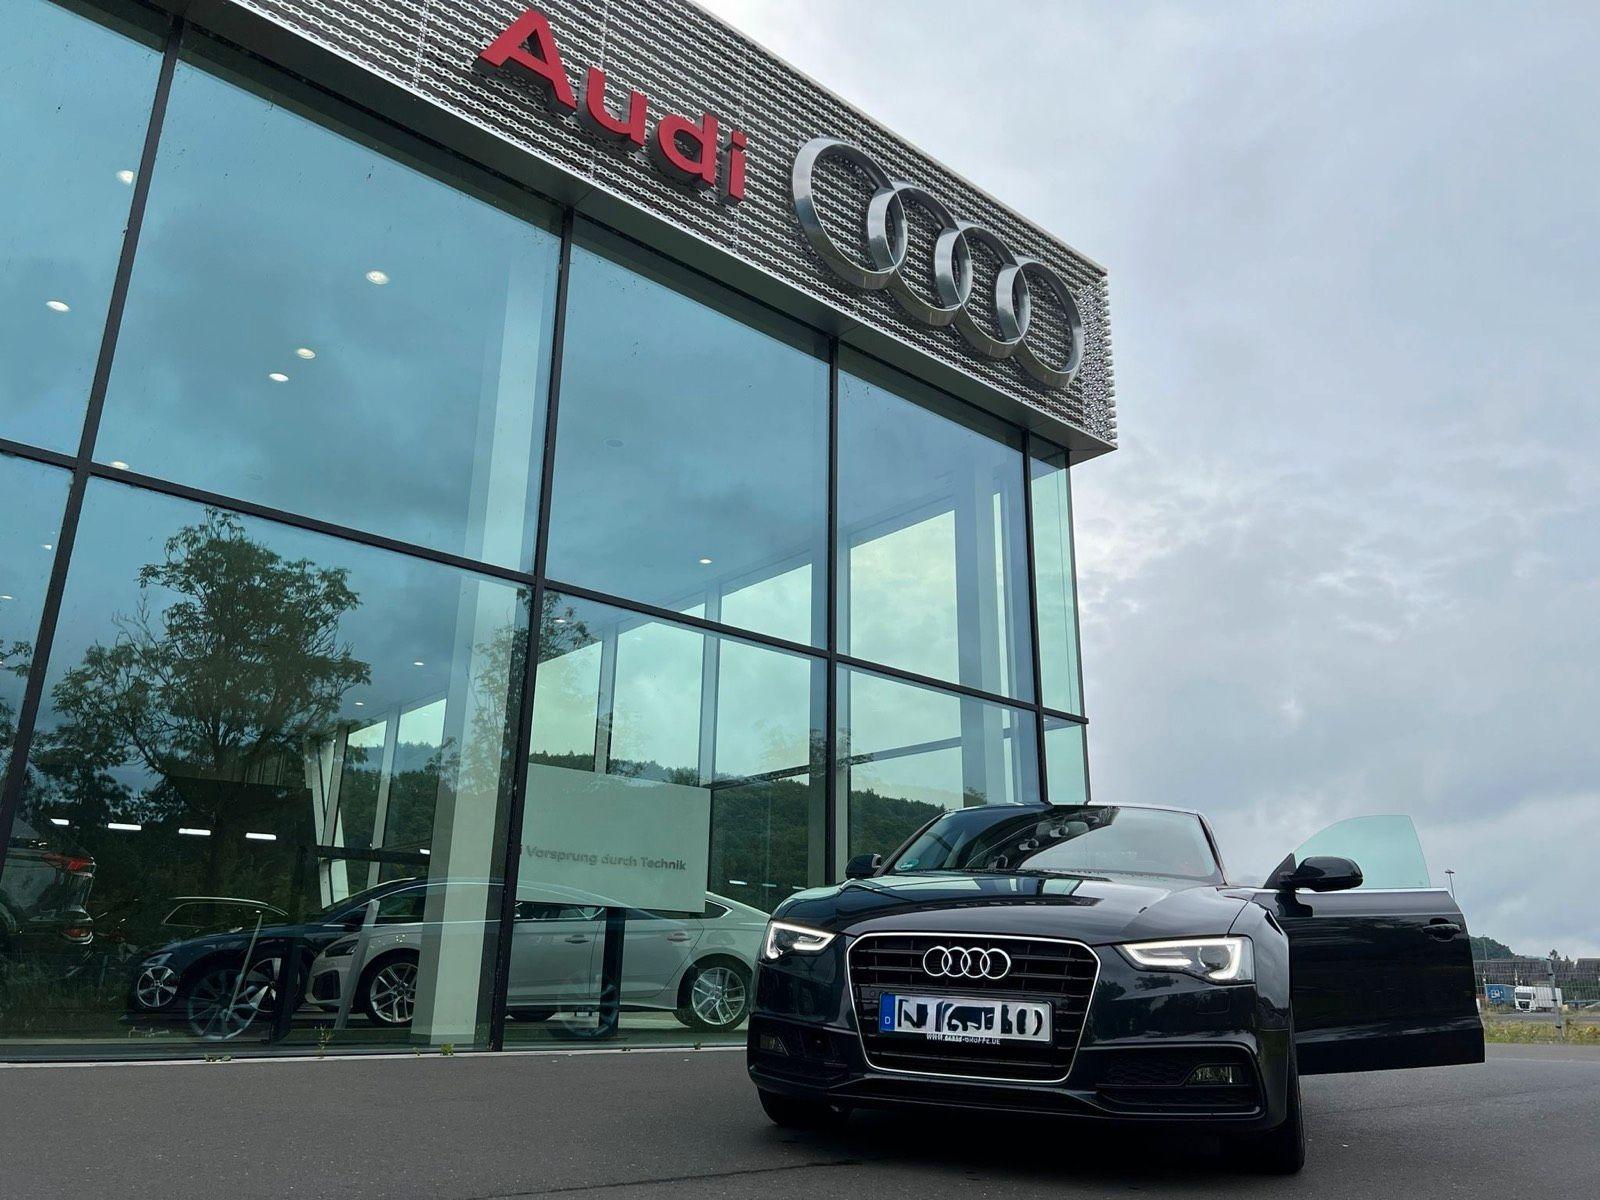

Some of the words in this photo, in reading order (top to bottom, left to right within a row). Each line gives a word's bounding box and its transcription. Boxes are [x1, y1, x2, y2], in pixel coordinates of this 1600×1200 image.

[477, 9, 748, 204] Audi
[526, 845, 598, 866] Vorsprung
[601, 854, 637, 868] durch
[640, 857, 686, 871] Technik
[884, 1016, 891, 1025] D
